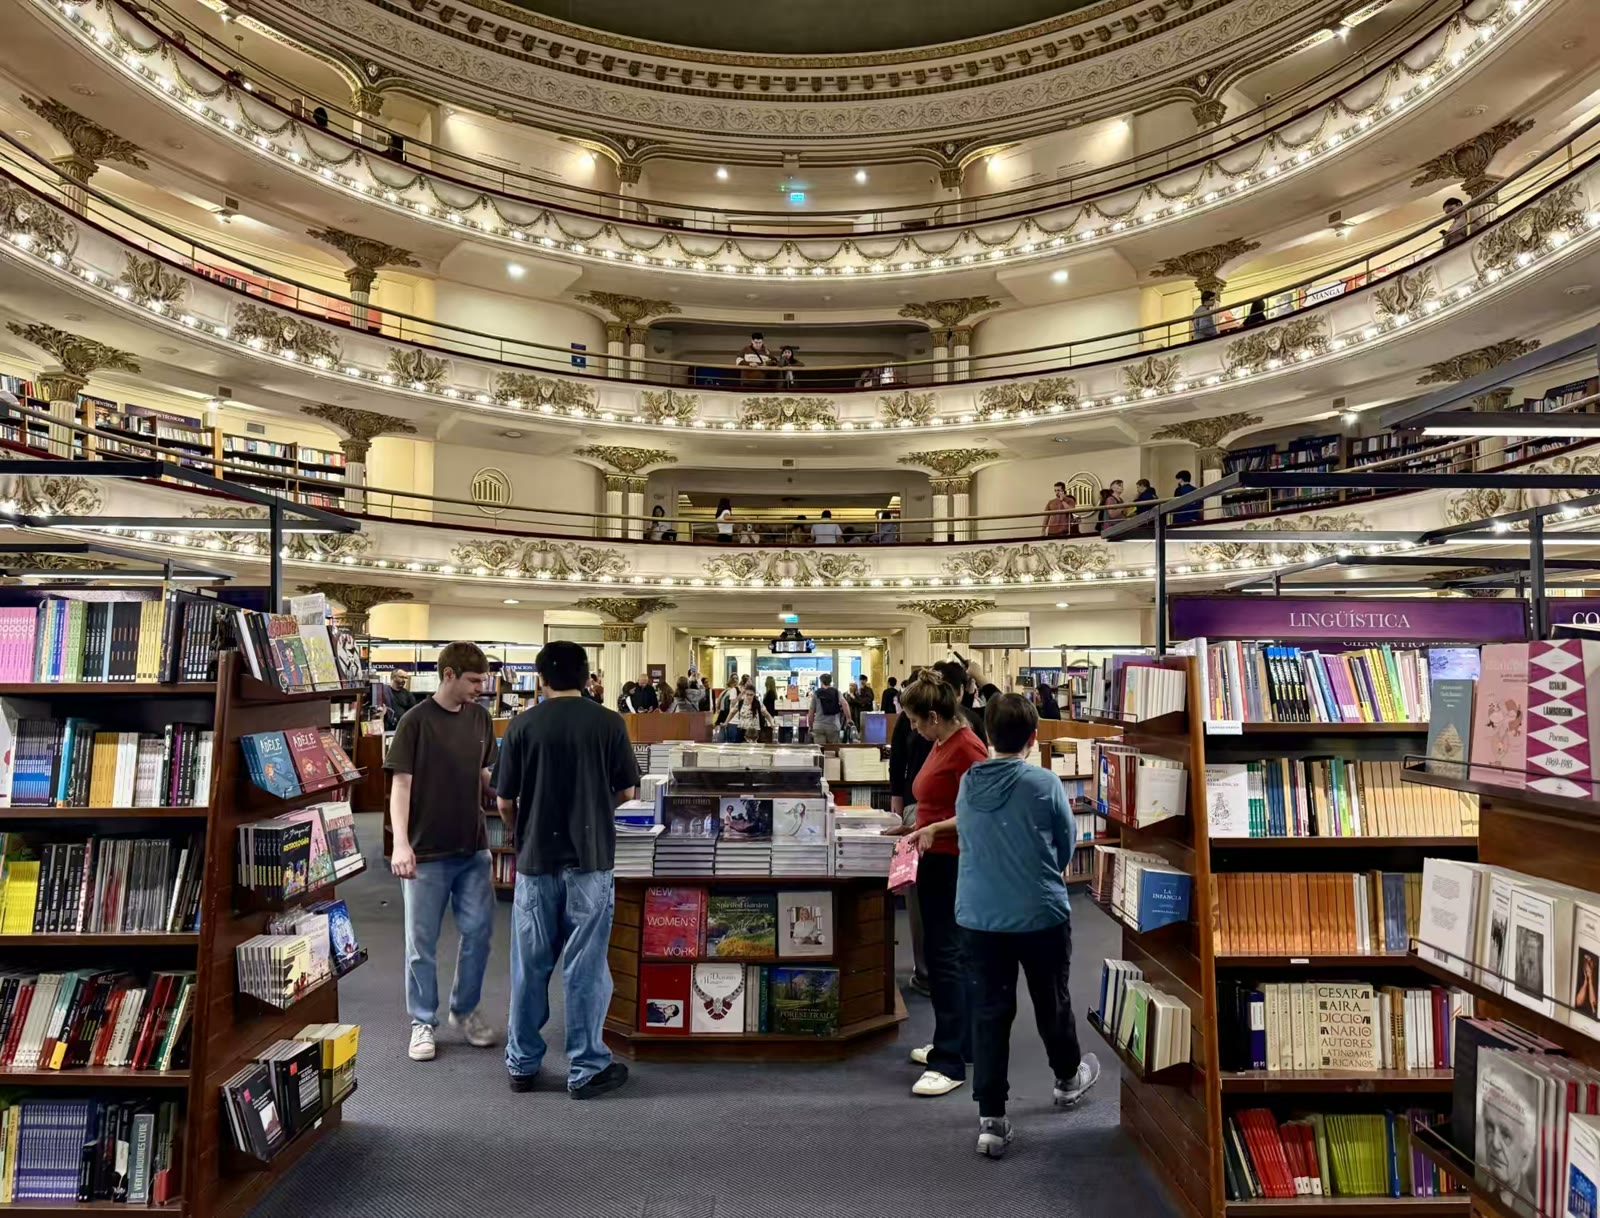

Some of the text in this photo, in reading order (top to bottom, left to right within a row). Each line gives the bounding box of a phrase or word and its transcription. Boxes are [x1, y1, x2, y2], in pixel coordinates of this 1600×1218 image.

[1311, 288, 1341, 302] MANGA
[1288, 610, 1411, 629] LINGÜÍSTICA
[1548, 731, 1569, 743] Poemas
[648, 886, 673, 896] NEW
[1152, 893, 1182, 901] INFANCIA
[744, 901, 769, 909] Garden
[647, 916, 697, 927] WOMEN'S
[663, 946, 696, 957] WORK
[1318, 987, 1361, 999] CESAR
[1328, 1001, 1361, 1012] AIRA
[1319, 1012, 1363, 1024] DICCIO
[1330, 1026, 1372, 1037] NARIO
[1321, 1037, 1373, 1048] AUTORES
[1321, 1048, 1373, 1058] LATINOAME
[1332, 1058, 1375, 1068] RICANOS
